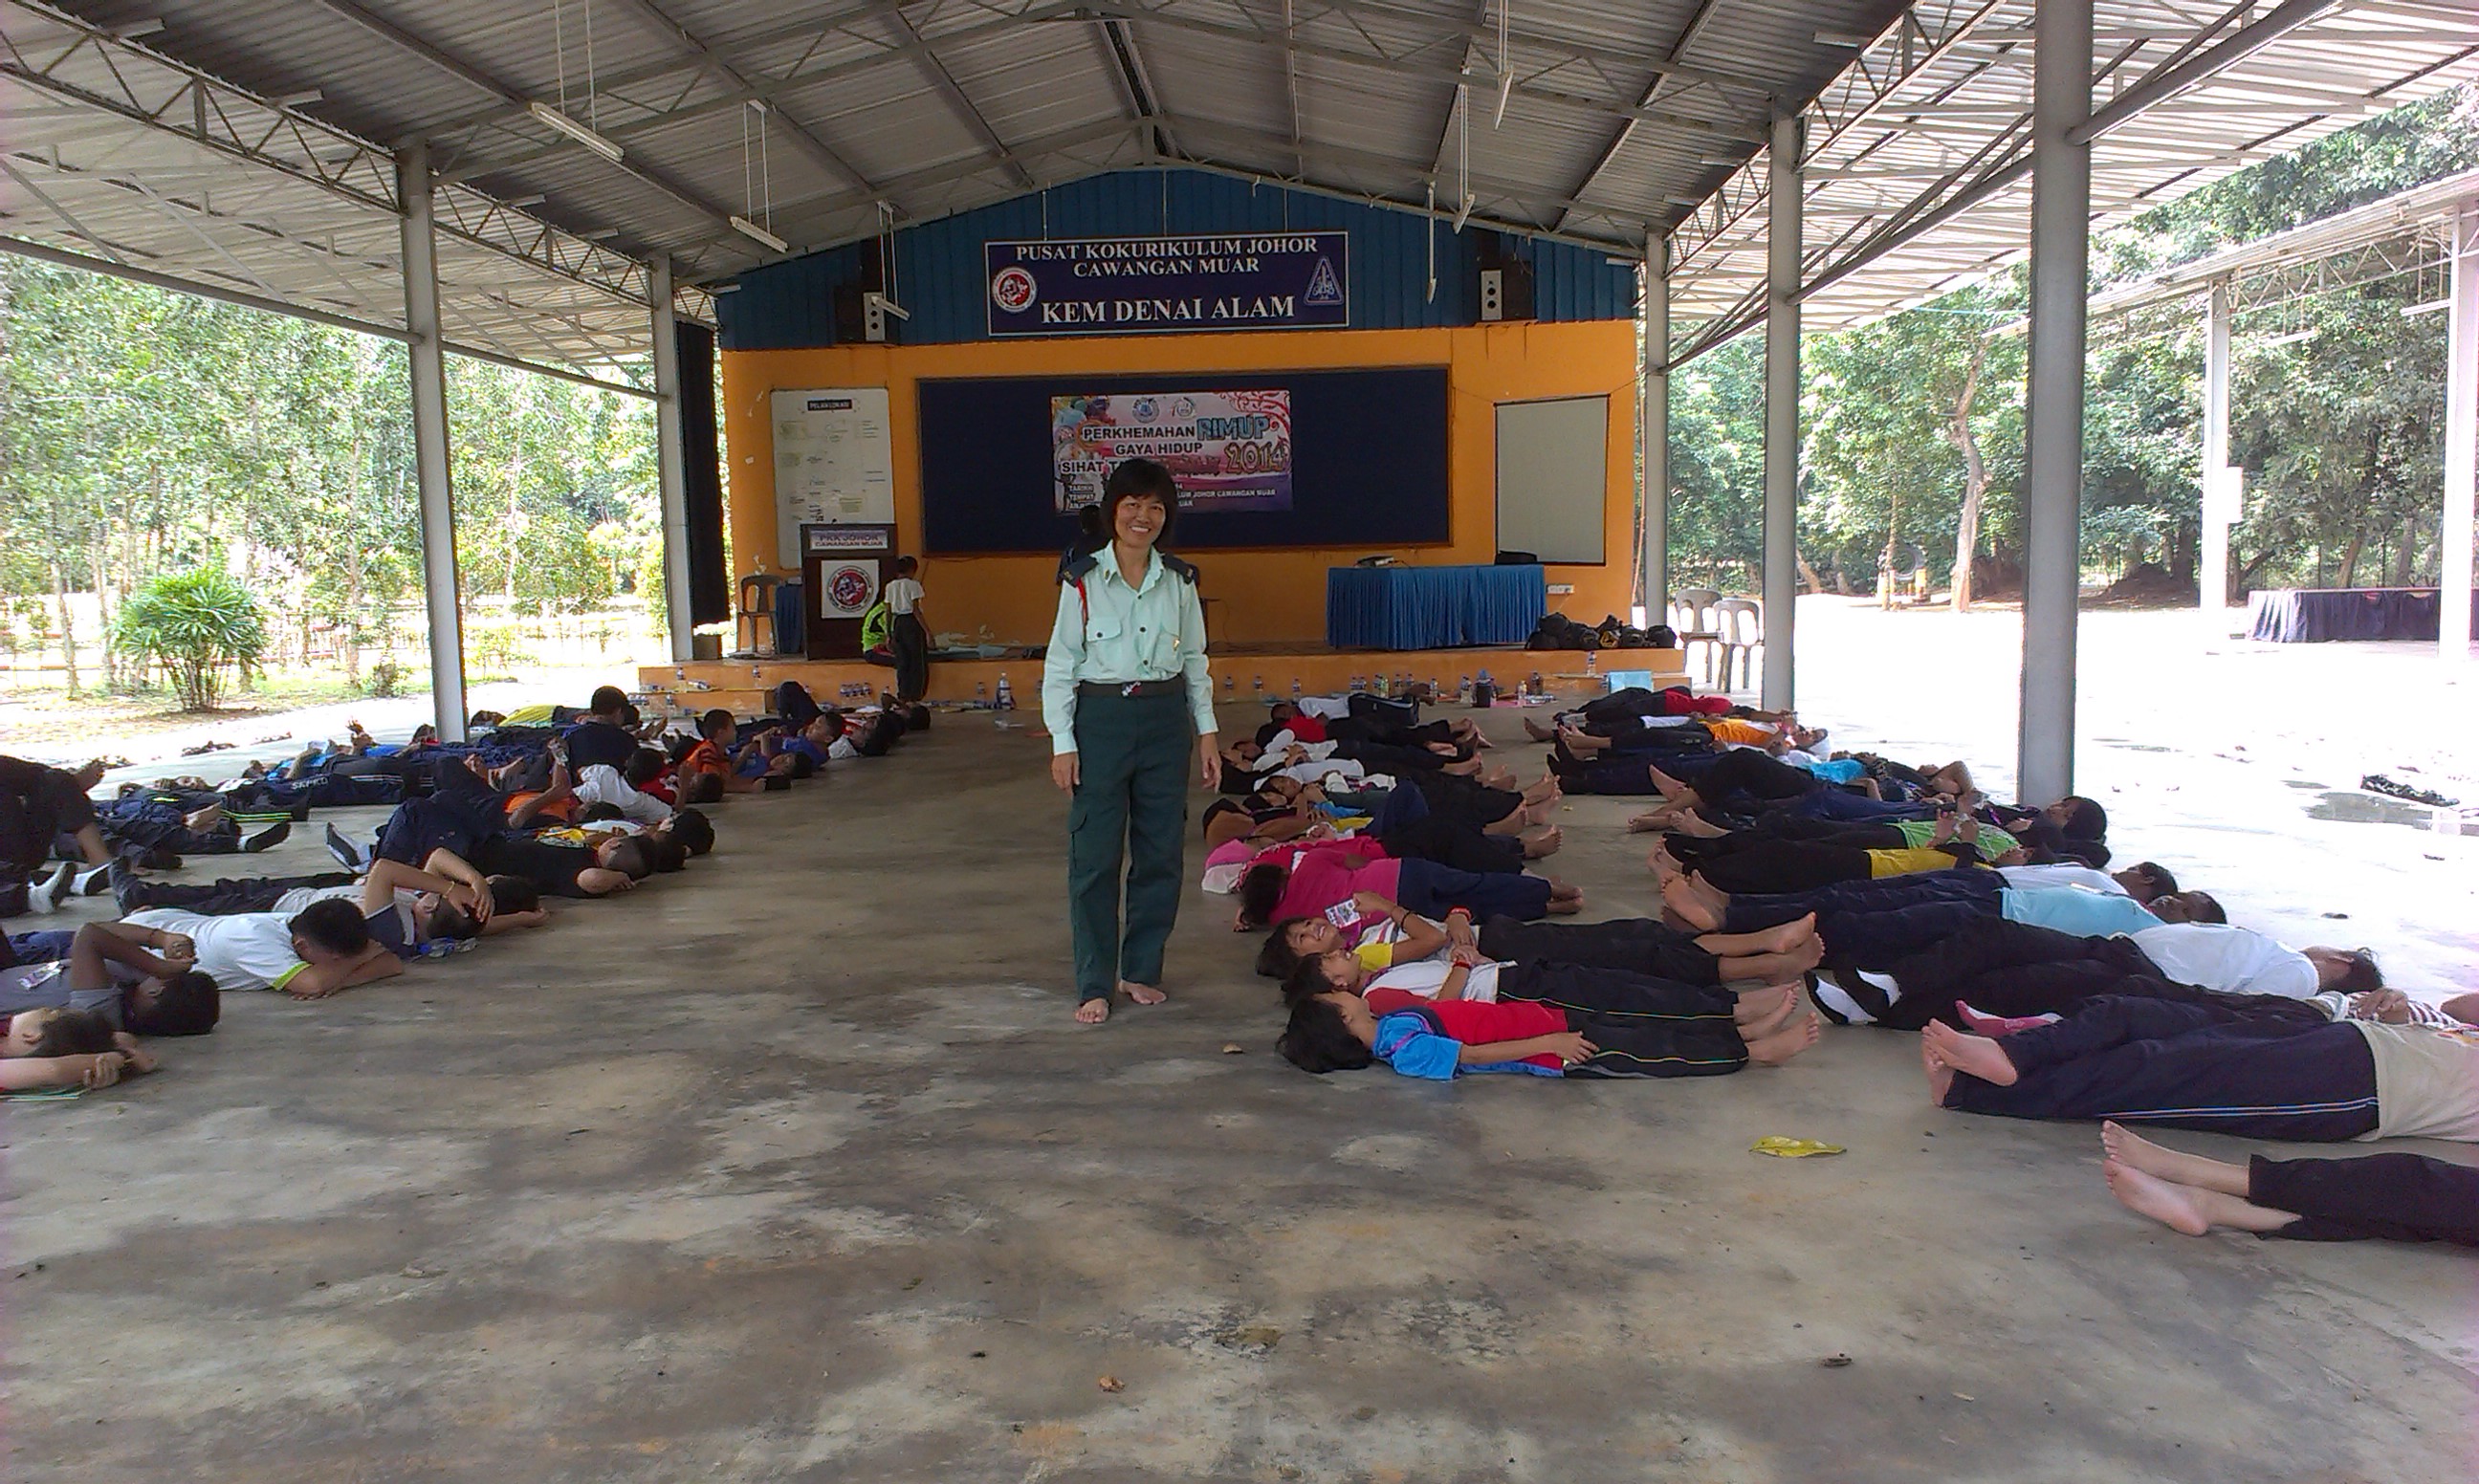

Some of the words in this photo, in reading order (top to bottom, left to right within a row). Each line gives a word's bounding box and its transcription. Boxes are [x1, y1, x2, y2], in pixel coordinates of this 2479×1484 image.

[1017, 245, 1079, 261] PUSAT
[1086, 241, 1241, 259] KOKURIKULUM
[1246, 237, 1318, 255] JOHOR
[1073, 259, 1194, 277] CAWANGAN
[1198, 257, 1260, 274] MUAR
[1042, 301, 1107, 323] KEM
[1114, 298, 1202, 322] DENAI
[1212, 295, 1295, 319] ALAM
[1083, 426, 1195, 440] PERKHEMAHAN
[1196, 417, 1270, 441] RIMUP
[1115, 443, 1153, 455] GAYA
[1157, 442, 1203, 454] HIDUP
[1224, 442, 1283, 474] 2014
[1062, 461, 1104, 473] SIHAT
